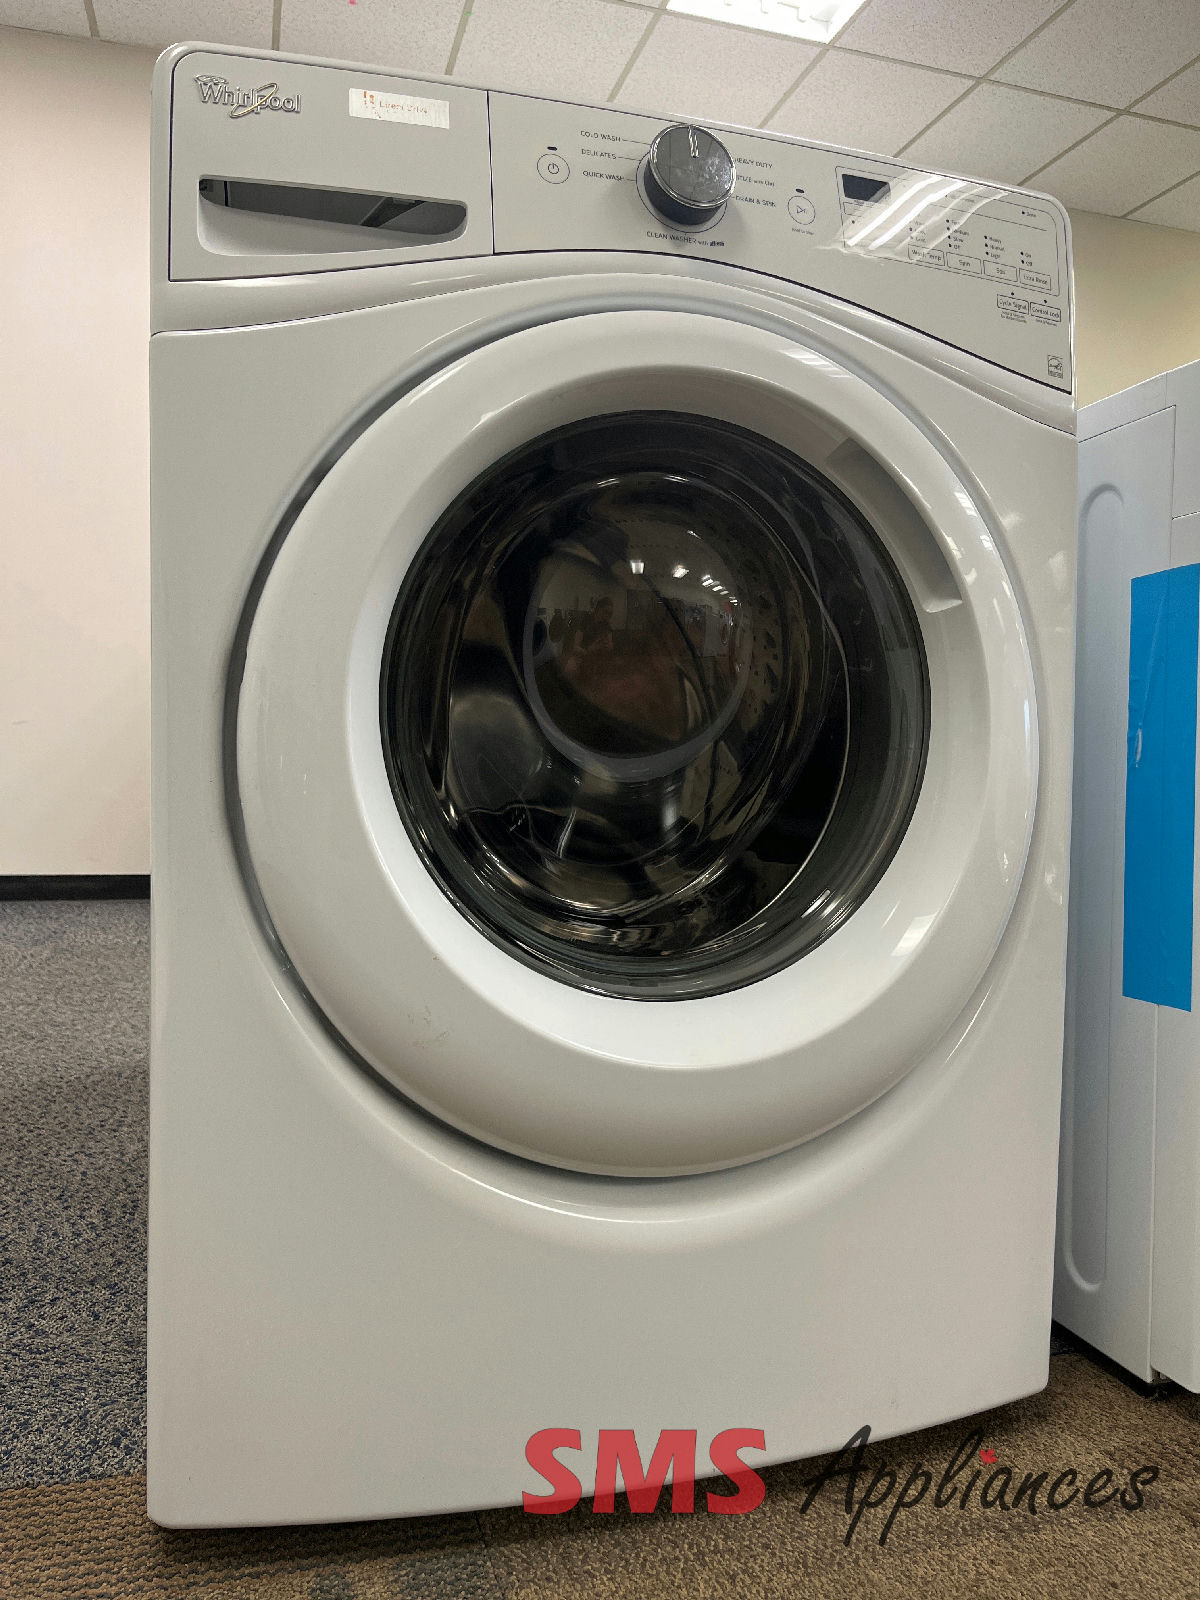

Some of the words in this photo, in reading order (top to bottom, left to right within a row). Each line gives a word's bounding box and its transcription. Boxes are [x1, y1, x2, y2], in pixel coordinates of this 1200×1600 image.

[198, 80, 302, 115] Whirlpool
[600, 133, 621, 142] WASH
[581, 148, 617, 160] DELICATES
[755, 161, 773, 169] DUTY
[582, 170, 604, 179] QUICK
[605, 173, 625, 182] WASH
[646, 230, 668, 240] CLEAN
[669, 234, 697, 244] WASHER
[958, 258, 971, 268] Spin
